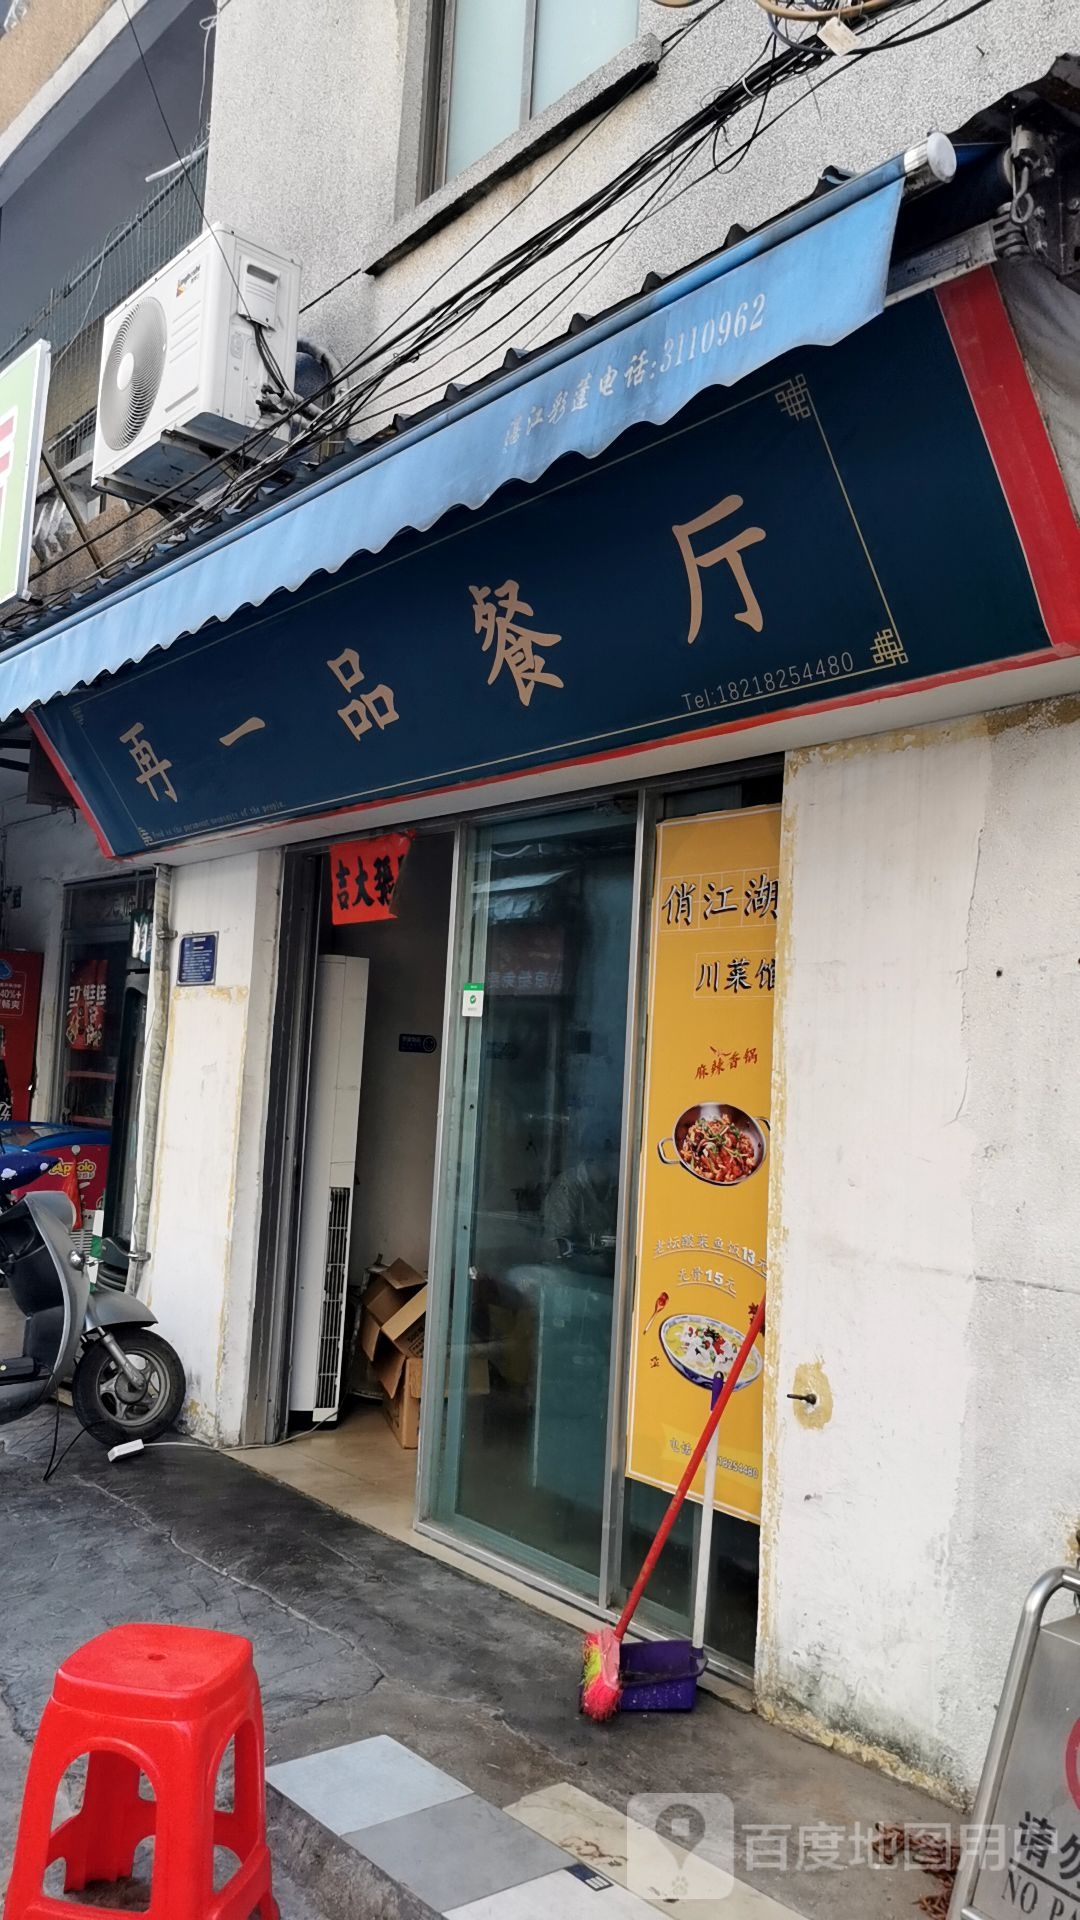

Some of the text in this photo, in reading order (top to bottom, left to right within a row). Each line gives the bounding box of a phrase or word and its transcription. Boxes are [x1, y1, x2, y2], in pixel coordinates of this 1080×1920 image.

[119, 494, 767, 804] 再一品餐厅
[662, 873, 779, 926] 俏江湖
[695, 957, 776, 994] 川菜馆
[695, 1048, 757, 1079] 麻辣香锅
[50, 1160, 95, 1175] Apolo
[1001, 1869, 1080, 1920] NO P
